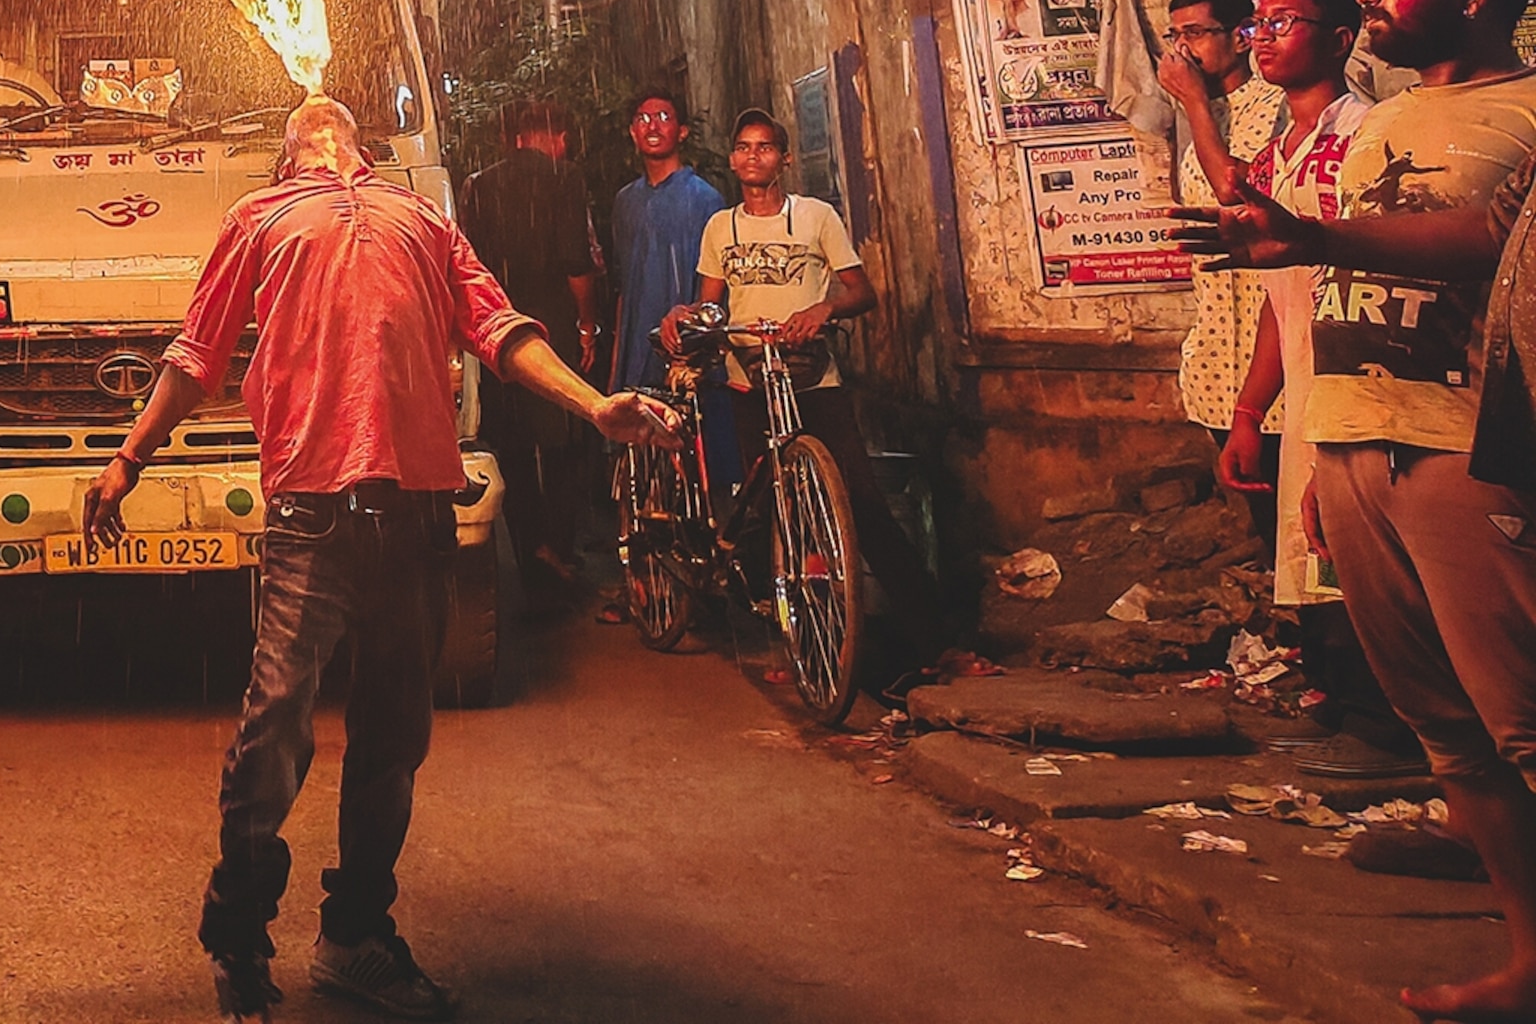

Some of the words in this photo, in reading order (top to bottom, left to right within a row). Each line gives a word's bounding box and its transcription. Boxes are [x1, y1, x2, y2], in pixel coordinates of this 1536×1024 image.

[53, 153, 93, 171] জয়
[107, 150, 137, 167] মা
[154, 148, 206, 166] তারা
[1030, 147, 1095, 163] Computer
[1093, 168, 1139, 183] Repair
[1079, 191, 1109, 206] Any
[1094, 210, 1133, 223] Camera
[1072, 230, 1144, 246] M-91430
[728, 256, 787, 270] JUNGLE
[1314, 281, 1438, 329] ART
[160, 538, 225, 565] 0252
